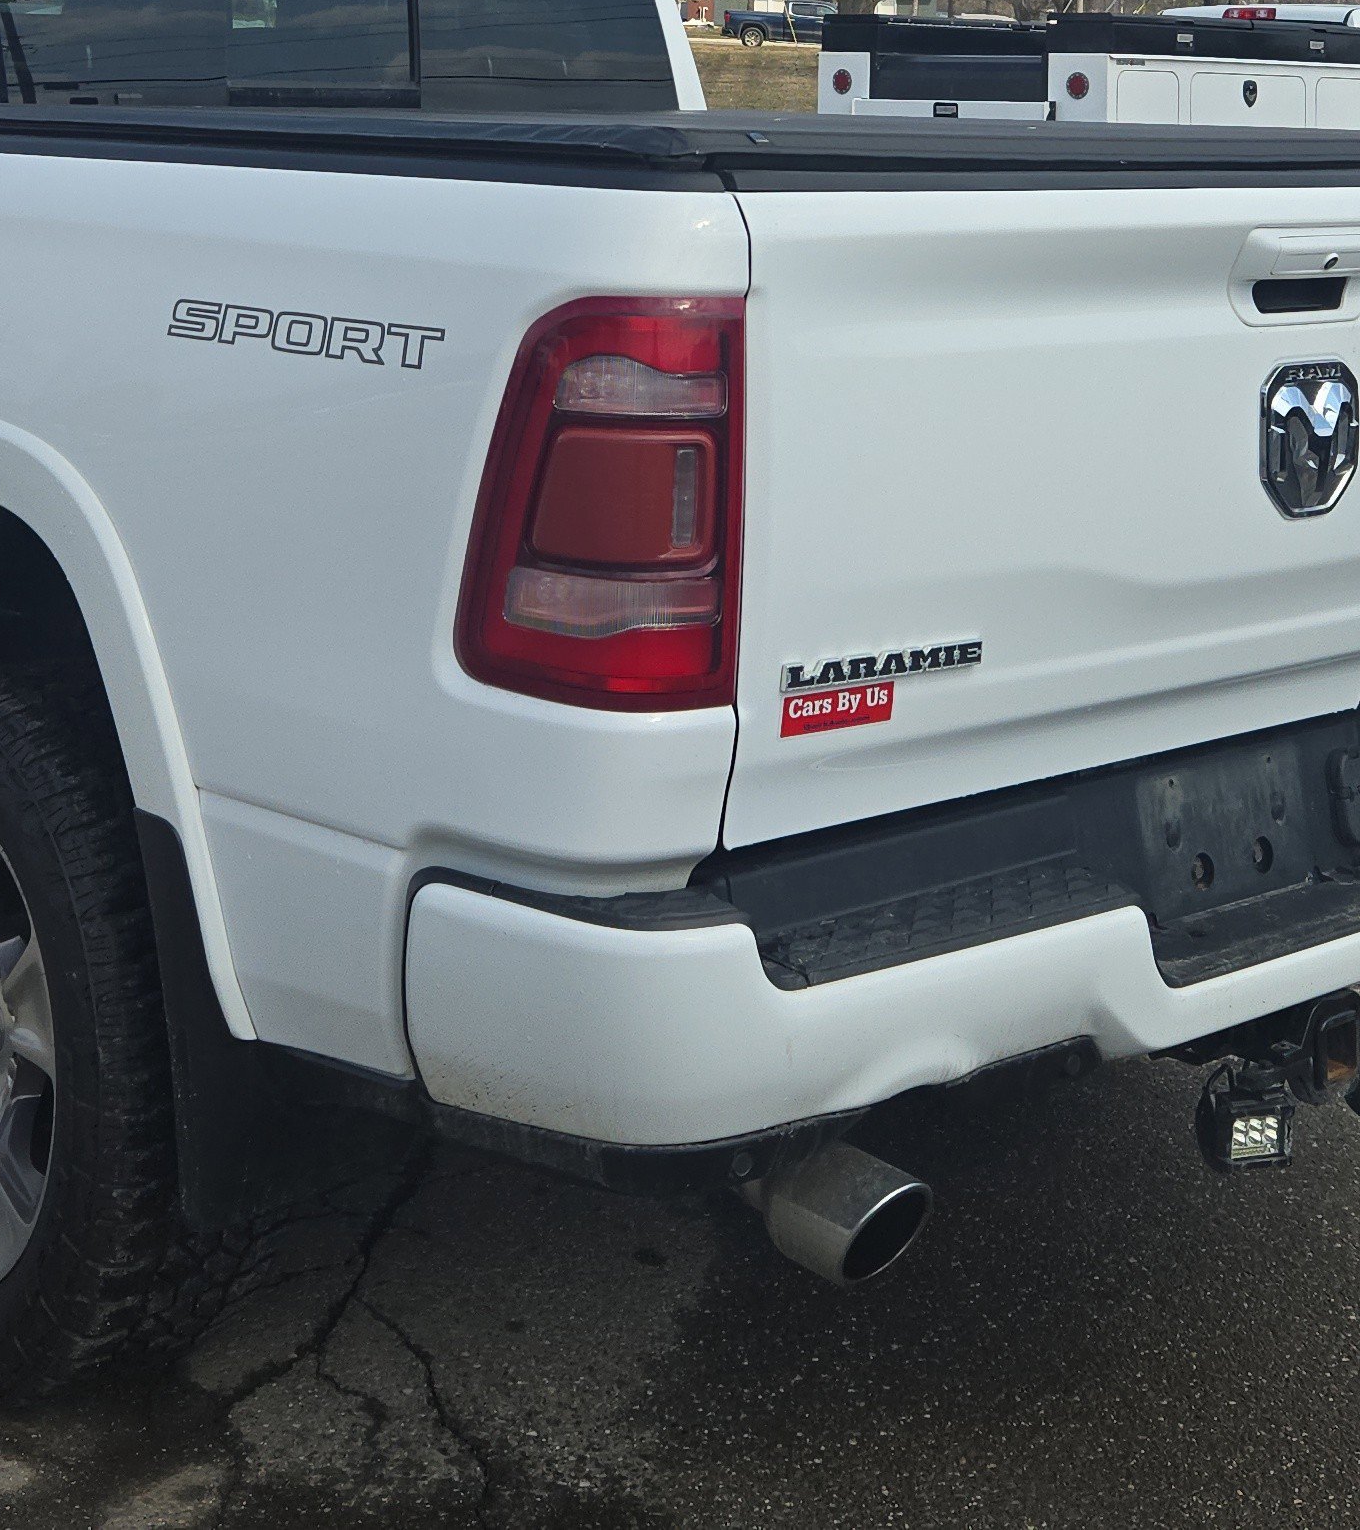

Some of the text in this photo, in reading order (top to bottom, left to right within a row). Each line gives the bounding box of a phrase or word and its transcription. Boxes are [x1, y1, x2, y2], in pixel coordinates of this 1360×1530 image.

[166, 298, 446, 370] SPORT
[1285, 363, 1342, 380] RAM
[782, 639, 983, 691] LARAMIE
[789, 687, 889, 719] Cars By Us
